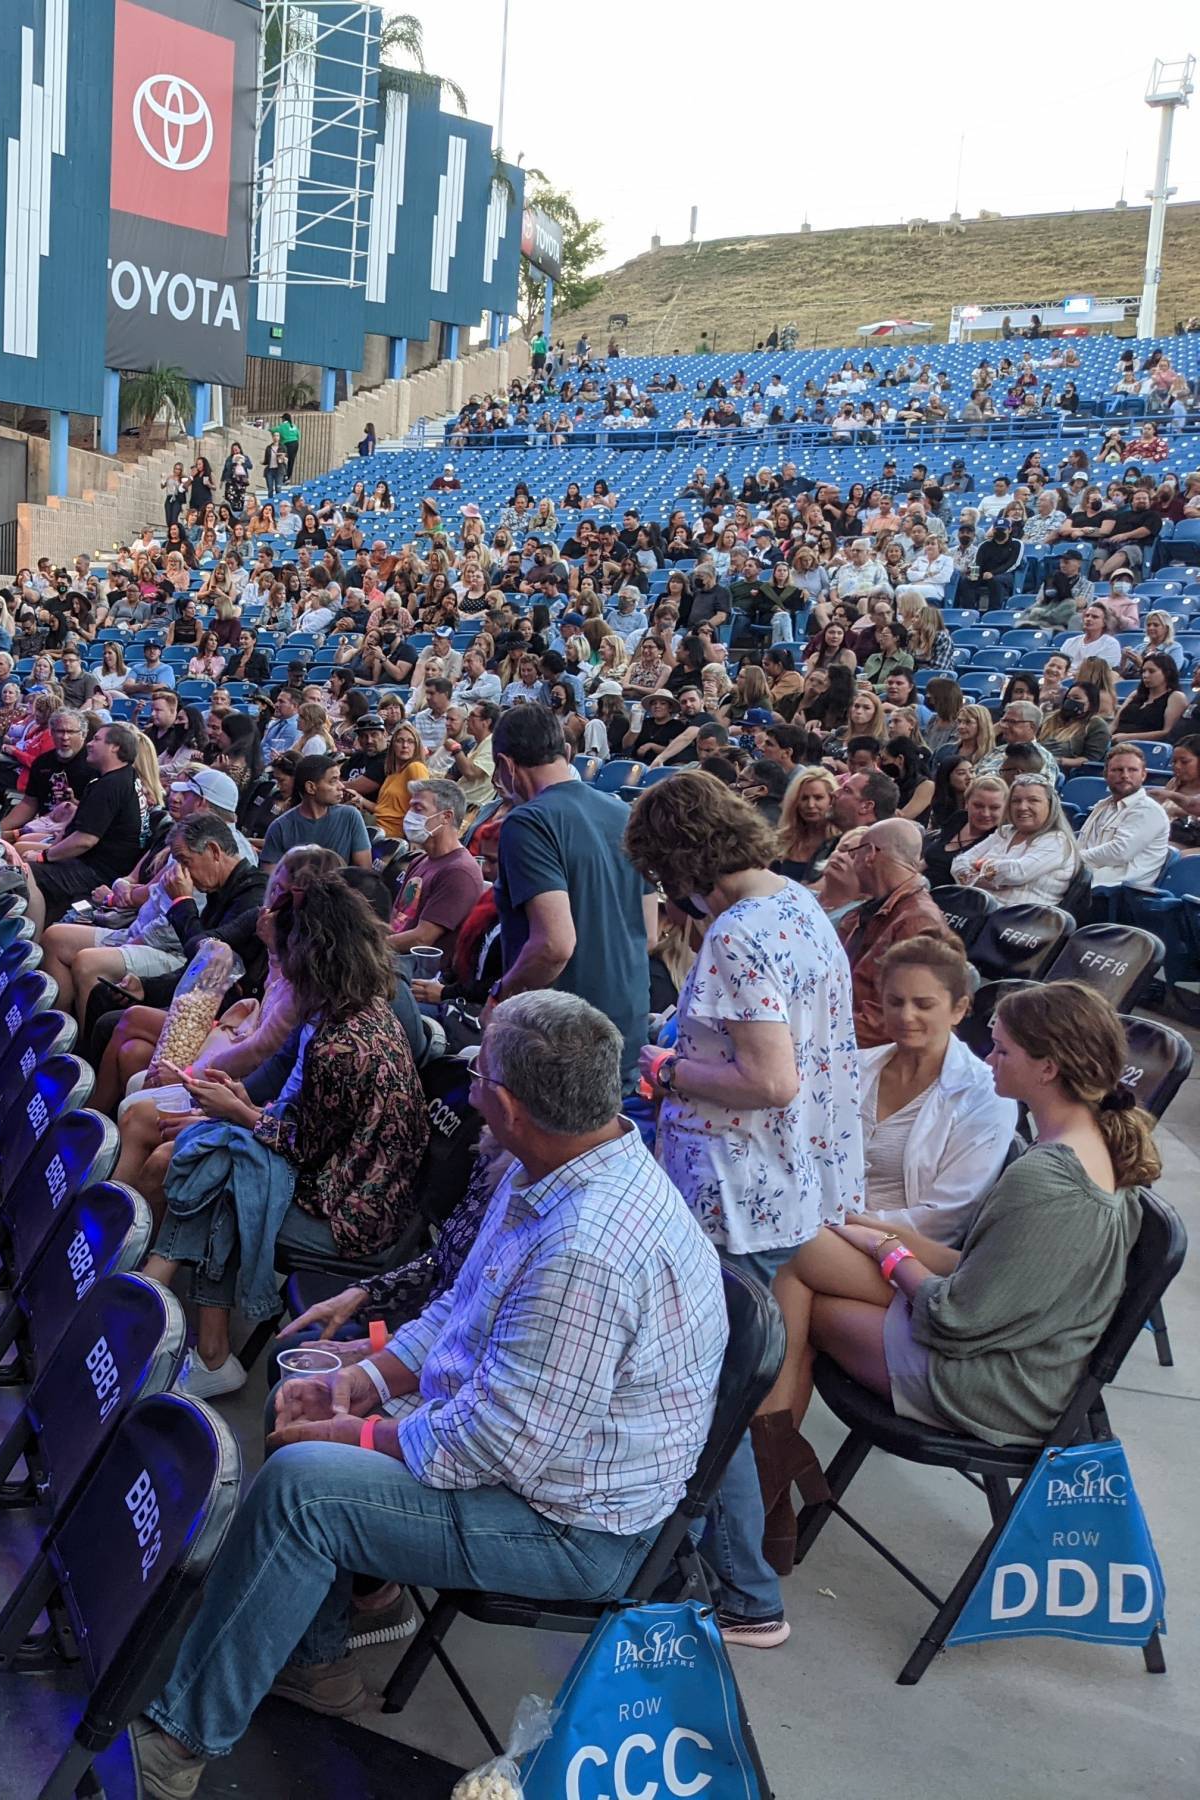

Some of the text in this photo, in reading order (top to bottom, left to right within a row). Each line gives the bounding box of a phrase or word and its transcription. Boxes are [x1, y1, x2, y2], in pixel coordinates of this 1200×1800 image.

[535, 224, 560, 264] TOYOTA
[107, 258, 241, 331] OYOTA
[1079, 950, 1129, 977] FFF16
[1052, 1531, 1100, 1547] ROW
[990, 1558, 1154, 1625] DDD
[614, 1660, 696, 1675] AMPHITHEATRE
[618, 1696, 662, 1723] ROW
[565, 1726, 714, 1800] CCC
